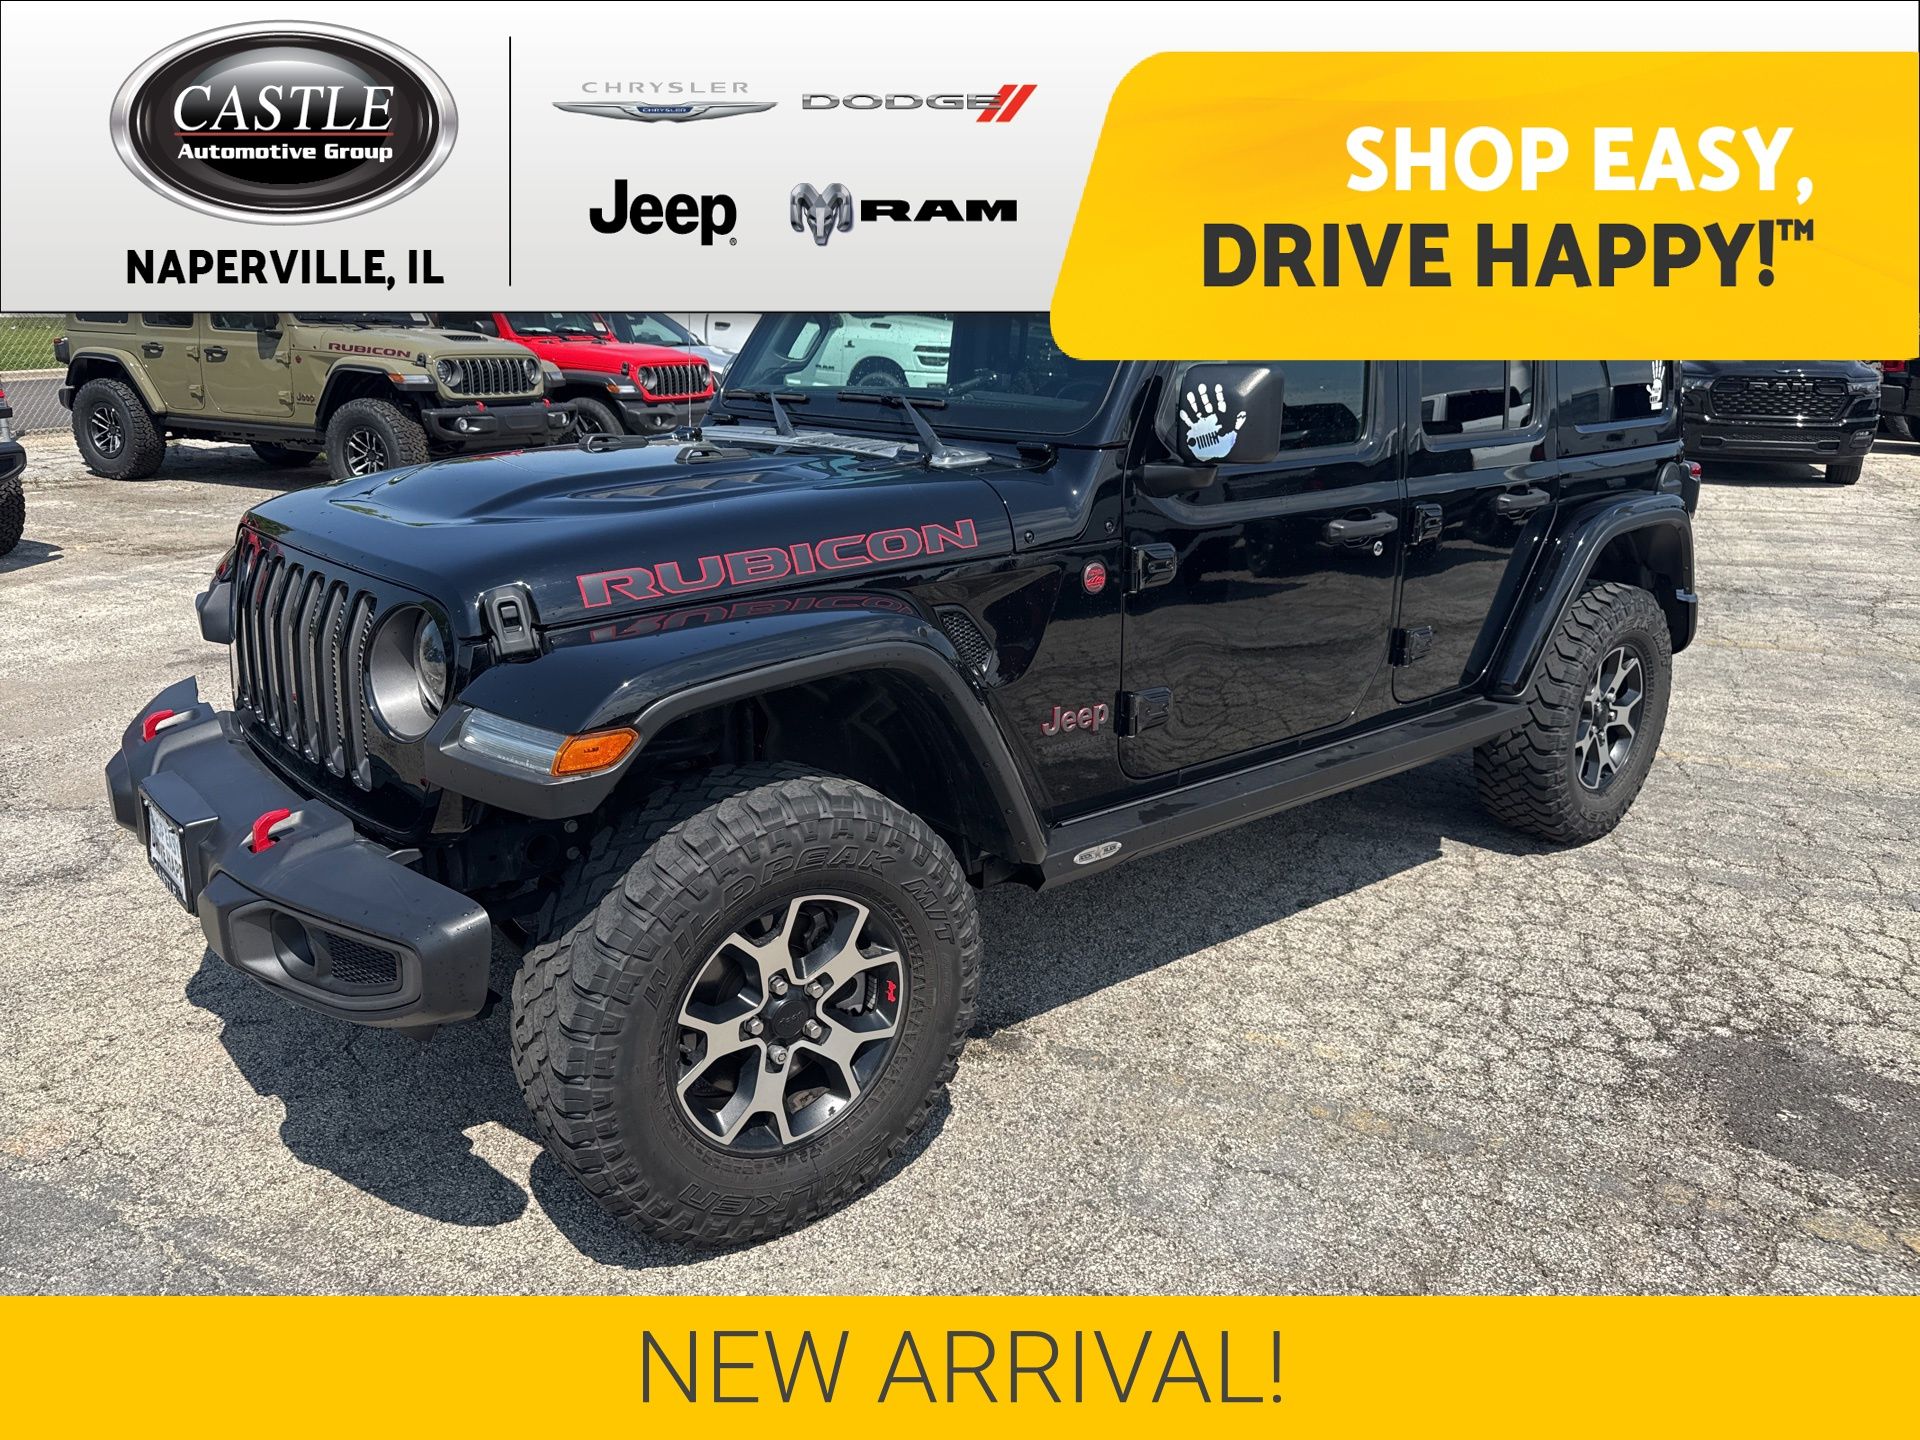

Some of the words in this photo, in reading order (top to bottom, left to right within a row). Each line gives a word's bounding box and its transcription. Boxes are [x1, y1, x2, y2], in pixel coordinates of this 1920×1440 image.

[328, 342, 411, 358] RUBICON
[1748, 381, 1815, 393] RAM
[576, 518, 979, 609] RUBICON
[1040, 703, 1109, 736] Jeep
